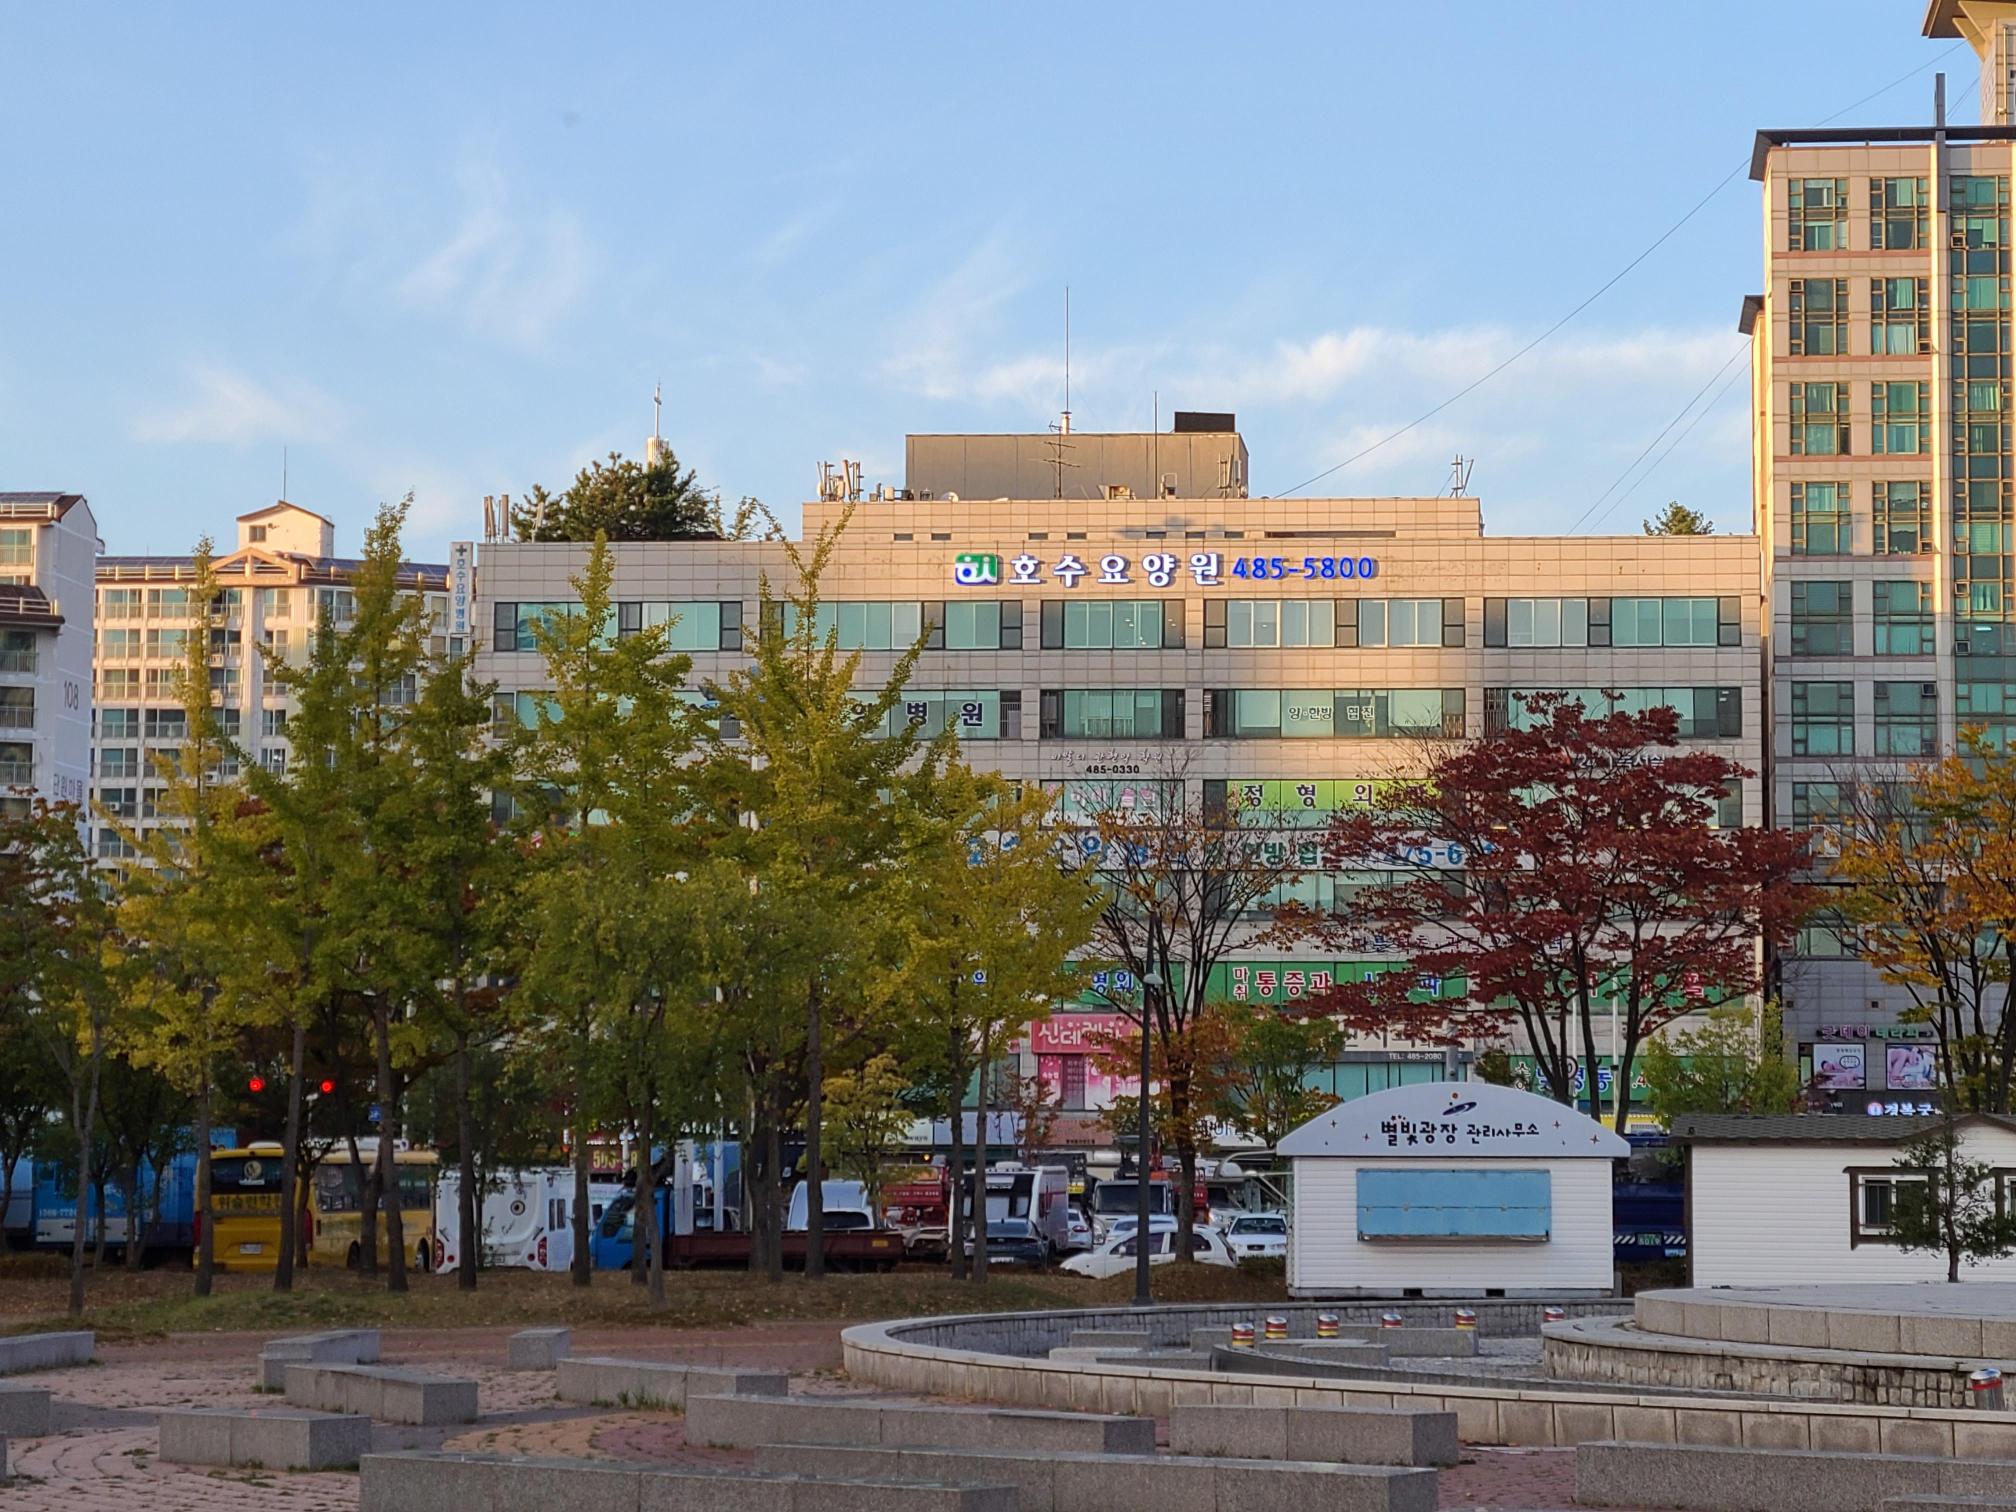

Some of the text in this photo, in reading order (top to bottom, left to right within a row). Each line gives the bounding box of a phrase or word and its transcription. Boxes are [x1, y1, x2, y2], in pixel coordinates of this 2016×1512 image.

[1008, 553, 1225, 588] 호수요양원
[1232, 556, 1377, 581] 485-5800
[63, 680, 80, 710] 108
[1346, 704, 1376, 721] 협진
[1086, 765, 1140, 774] 485-0330
[1255, 971, 1332, 997] 통증과
[1381, 1119, 1540, 1147] 별빛광장 관리사무소
